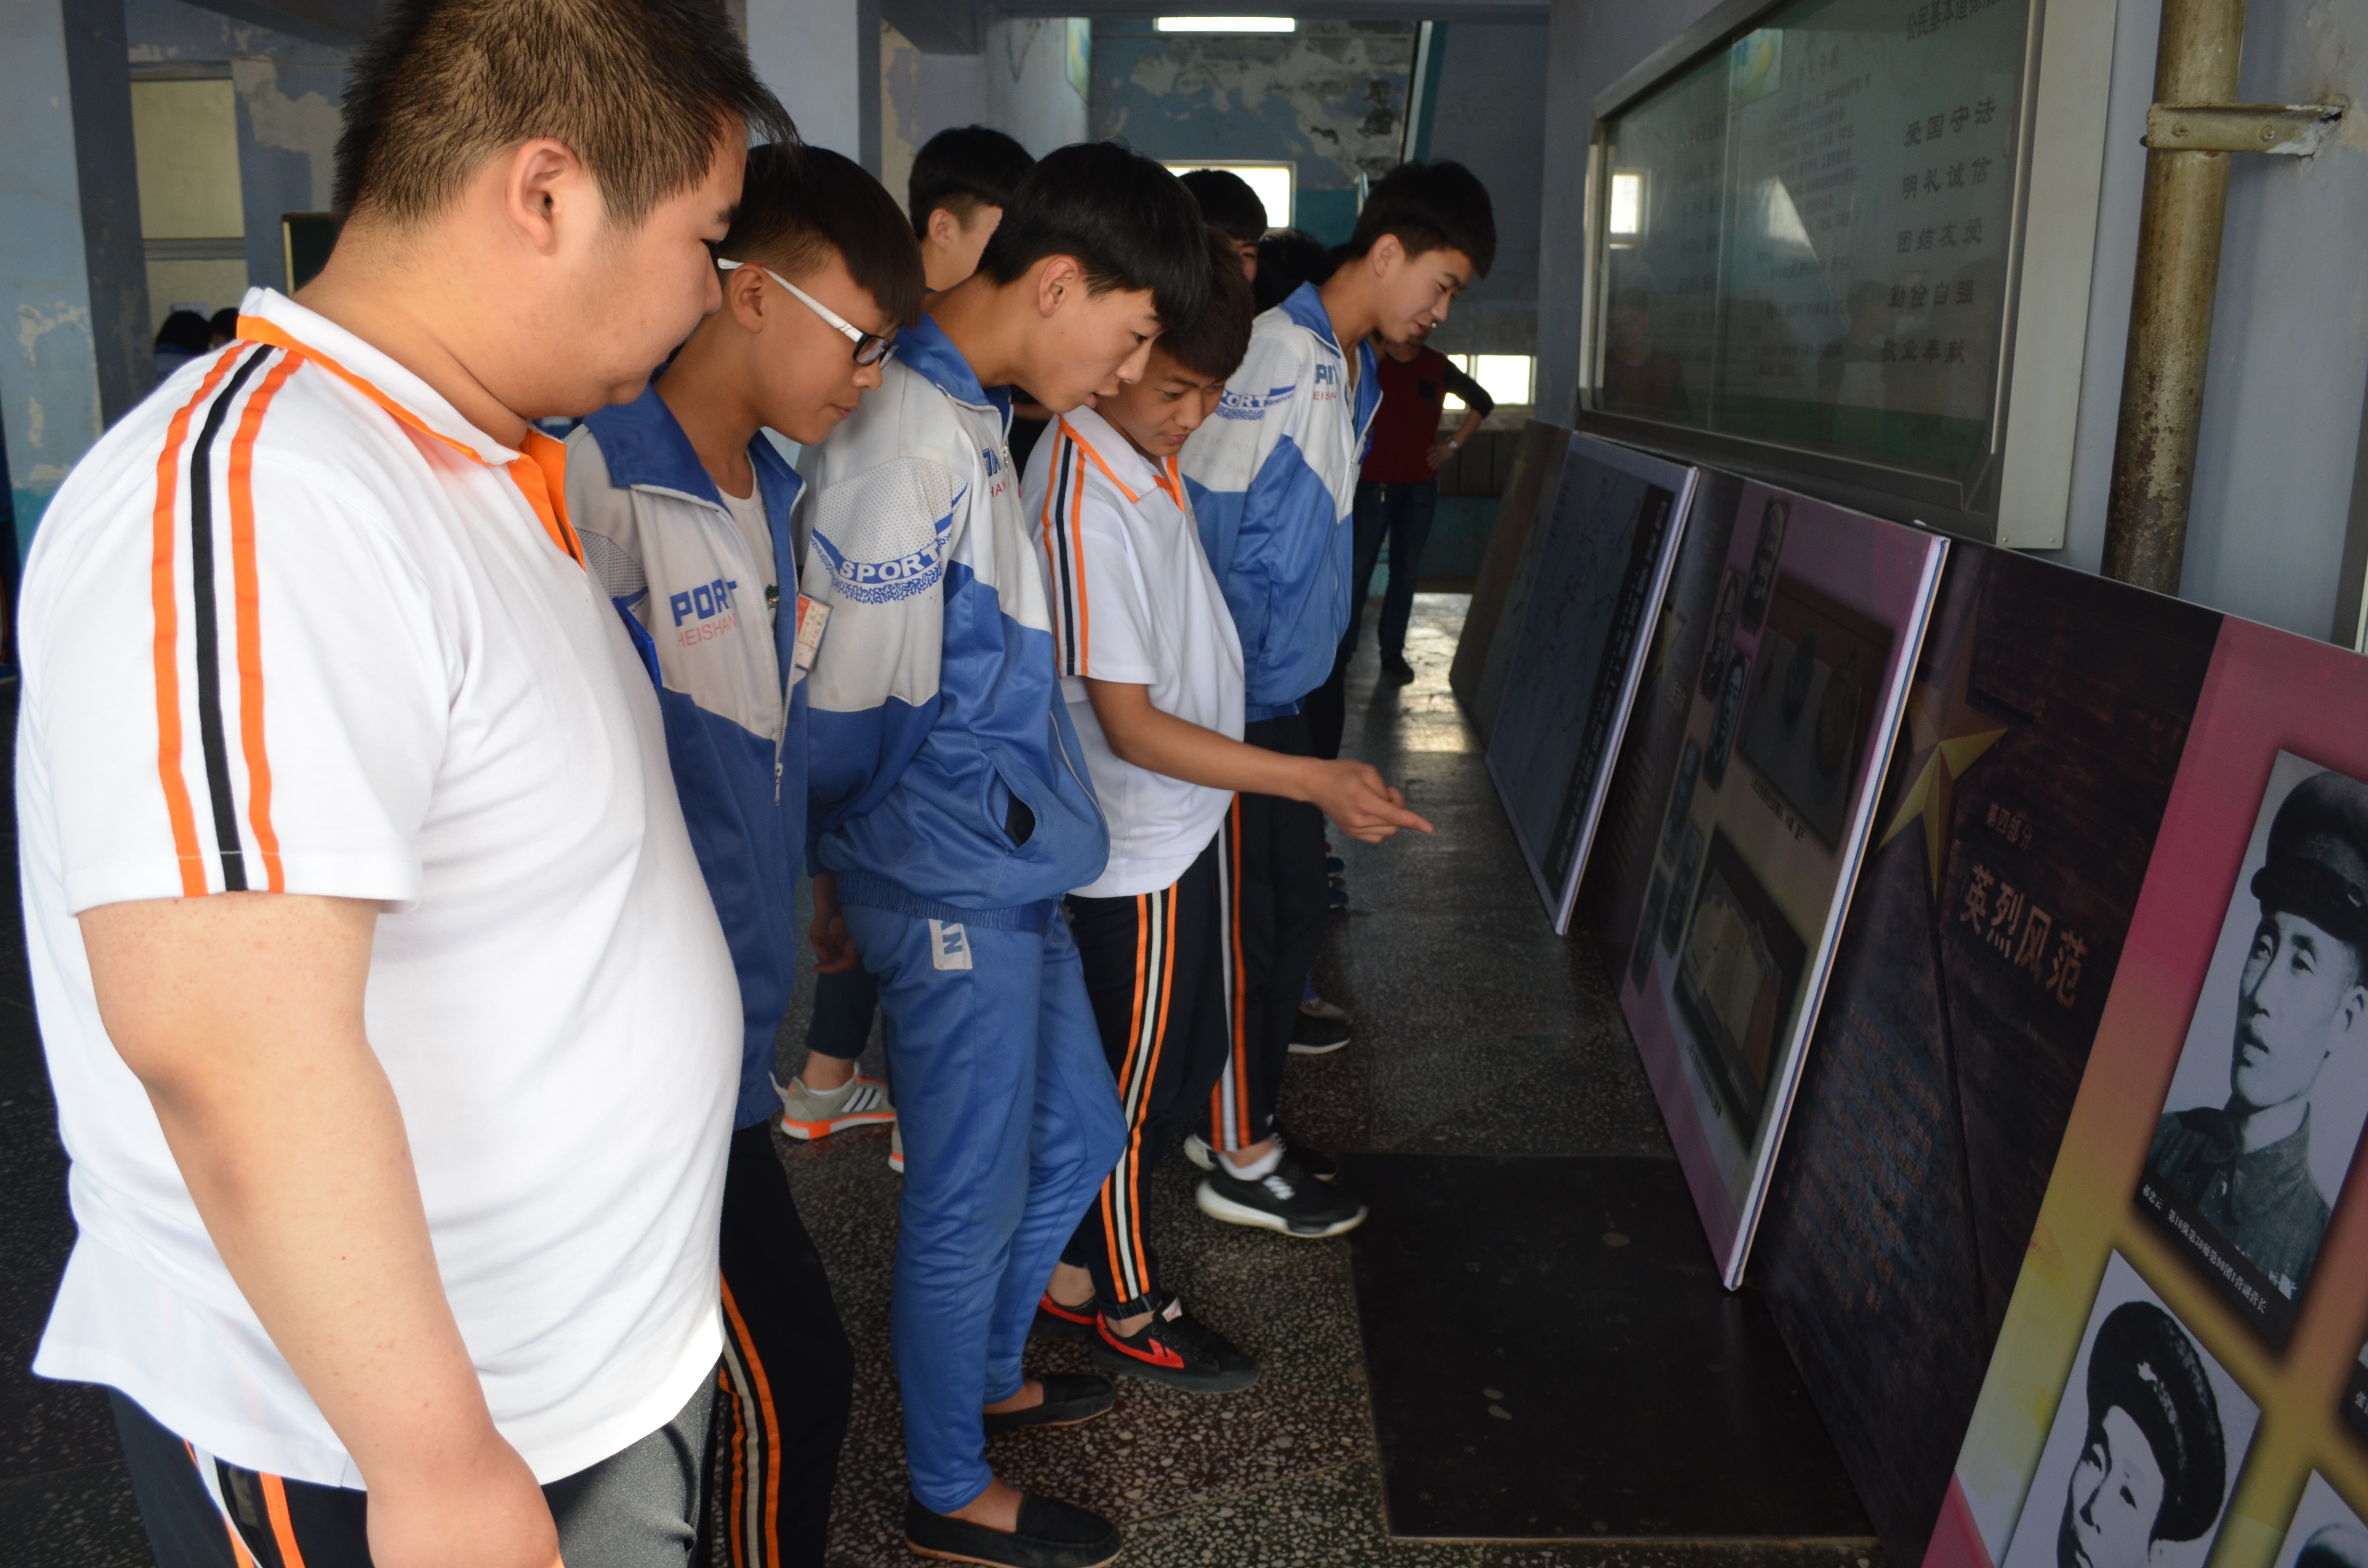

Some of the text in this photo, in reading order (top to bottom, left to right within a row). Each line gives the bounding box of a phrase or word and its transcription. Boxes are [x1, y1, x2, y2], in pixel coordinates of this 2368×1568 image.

[1904, 96, 1996, 147] 爱国守法
[1902, 156, 1992, 199] 明礼诚信
[1897, 217, 1983, 253] 团结友爱
[1888, 280, 1974, 308] 勤俭自强
[1881, 337, 1967, 364] 敬业奉献
[840, 541, 938, 582] SPORT
[1986, 800, 2033, 850] 第四部分
[1960, 864, 2090, 1008] 英烈风范
